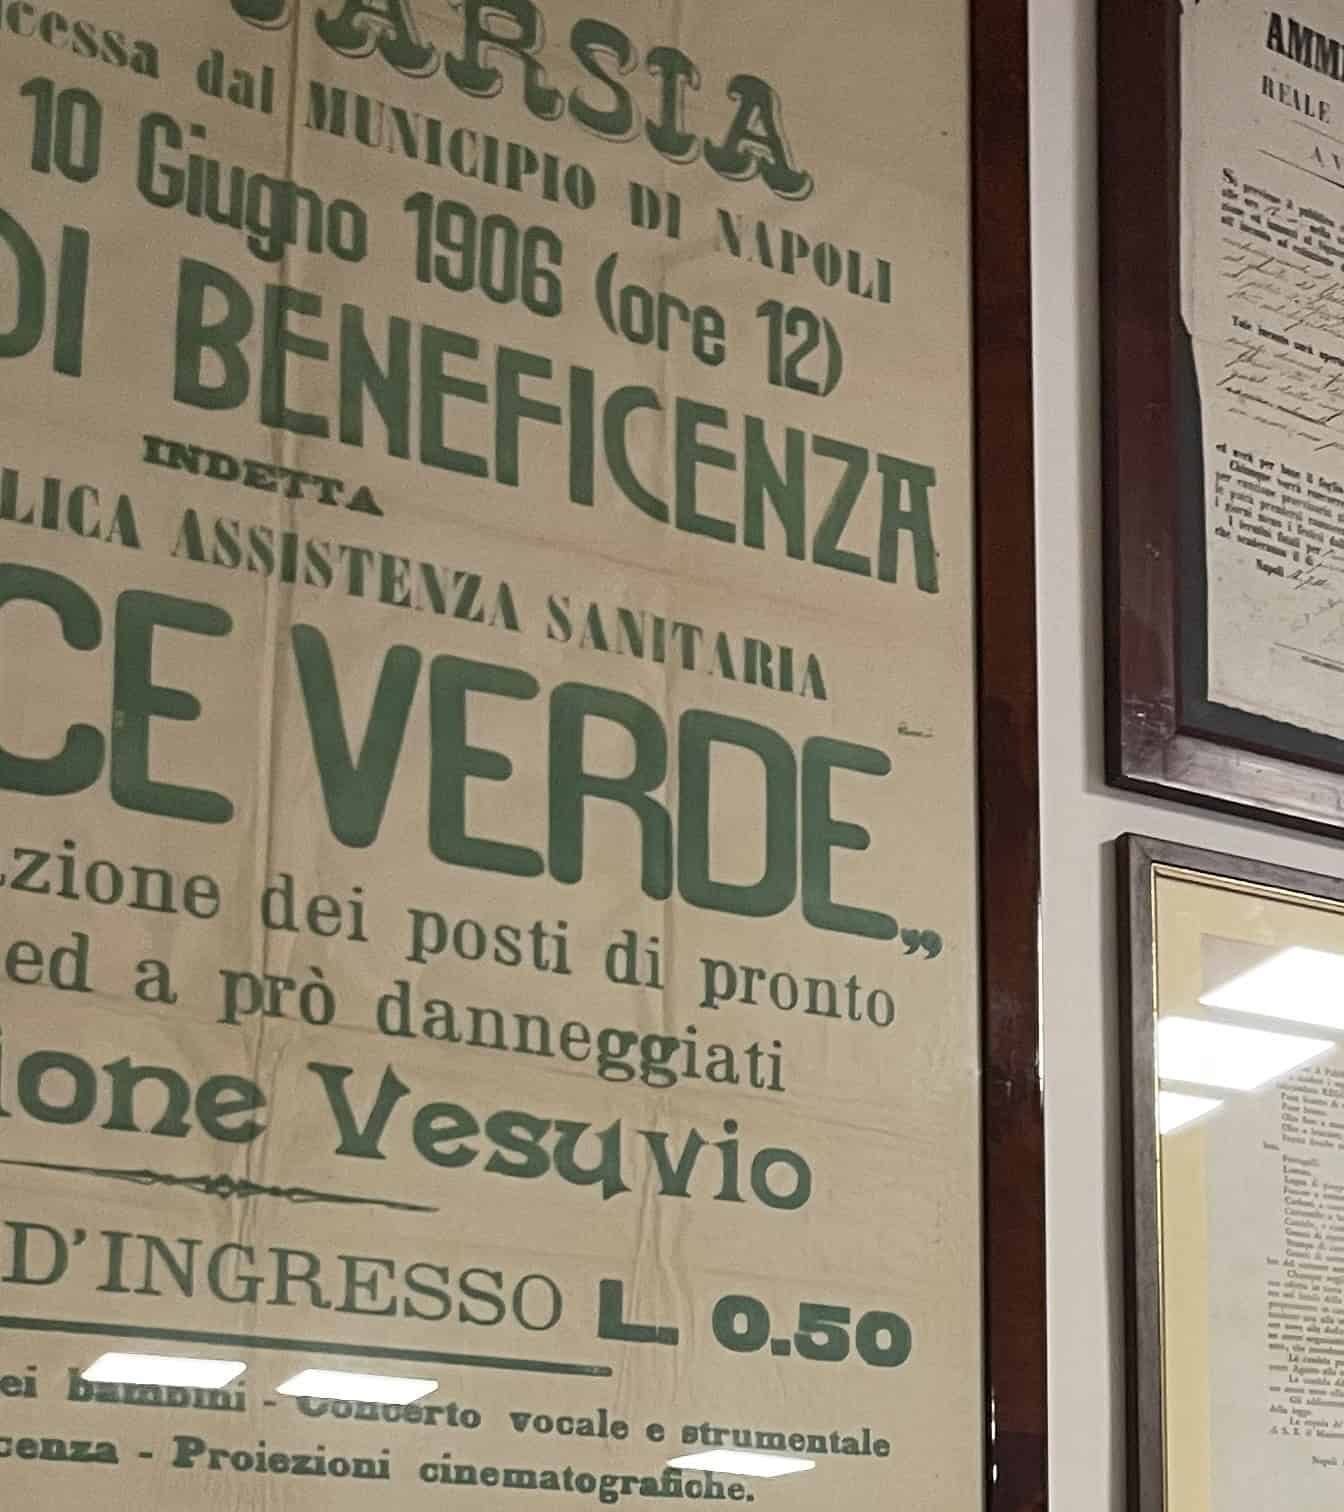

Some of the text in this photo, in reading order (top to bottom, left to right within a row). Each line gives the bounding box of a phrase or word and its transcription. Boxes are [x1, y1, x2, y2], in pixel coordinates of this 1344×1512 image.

[197, 49, 274, 115] dal
[305, 80, 596, 210] MUNICIPIO
[628, 181, 681, 240] DI
[717, 206, 893, 306] NAPOLI
[233, 0, 813, 200] ARSIA
[1262, 75, 1331, 124] REALE
[20, 77, 844, 398] 10 Giugno 1906 (ore 12)
[142, 435, 384, 518] INDETTA
[174, 255, 940, 595] BENEFICENZA
[0, 562, 235, 824] CE
[171, 506, 521, 632] ASSISTENZA
[547, 595, 828, 702] SANITARIA
[0, 838, 897, 1029] zione dei posti di pronto
[4, 929, 787, 1095] ed a prò danneggiati
[307, 1060, 813, 1212] Vesuvio
[2, 1220, 563, 1333] D'INGRESSO
[711, 1294, 913, 1370] 0.50
[173, 1435, 390, 1480] Proiezioni
[420, 1453, 754, 1504] cinematografiche.
[510, 1409, 629, 1440] vocale
[646, 1424, 665, 1442] e
[681, 1422, 890, 1457] strumentale
